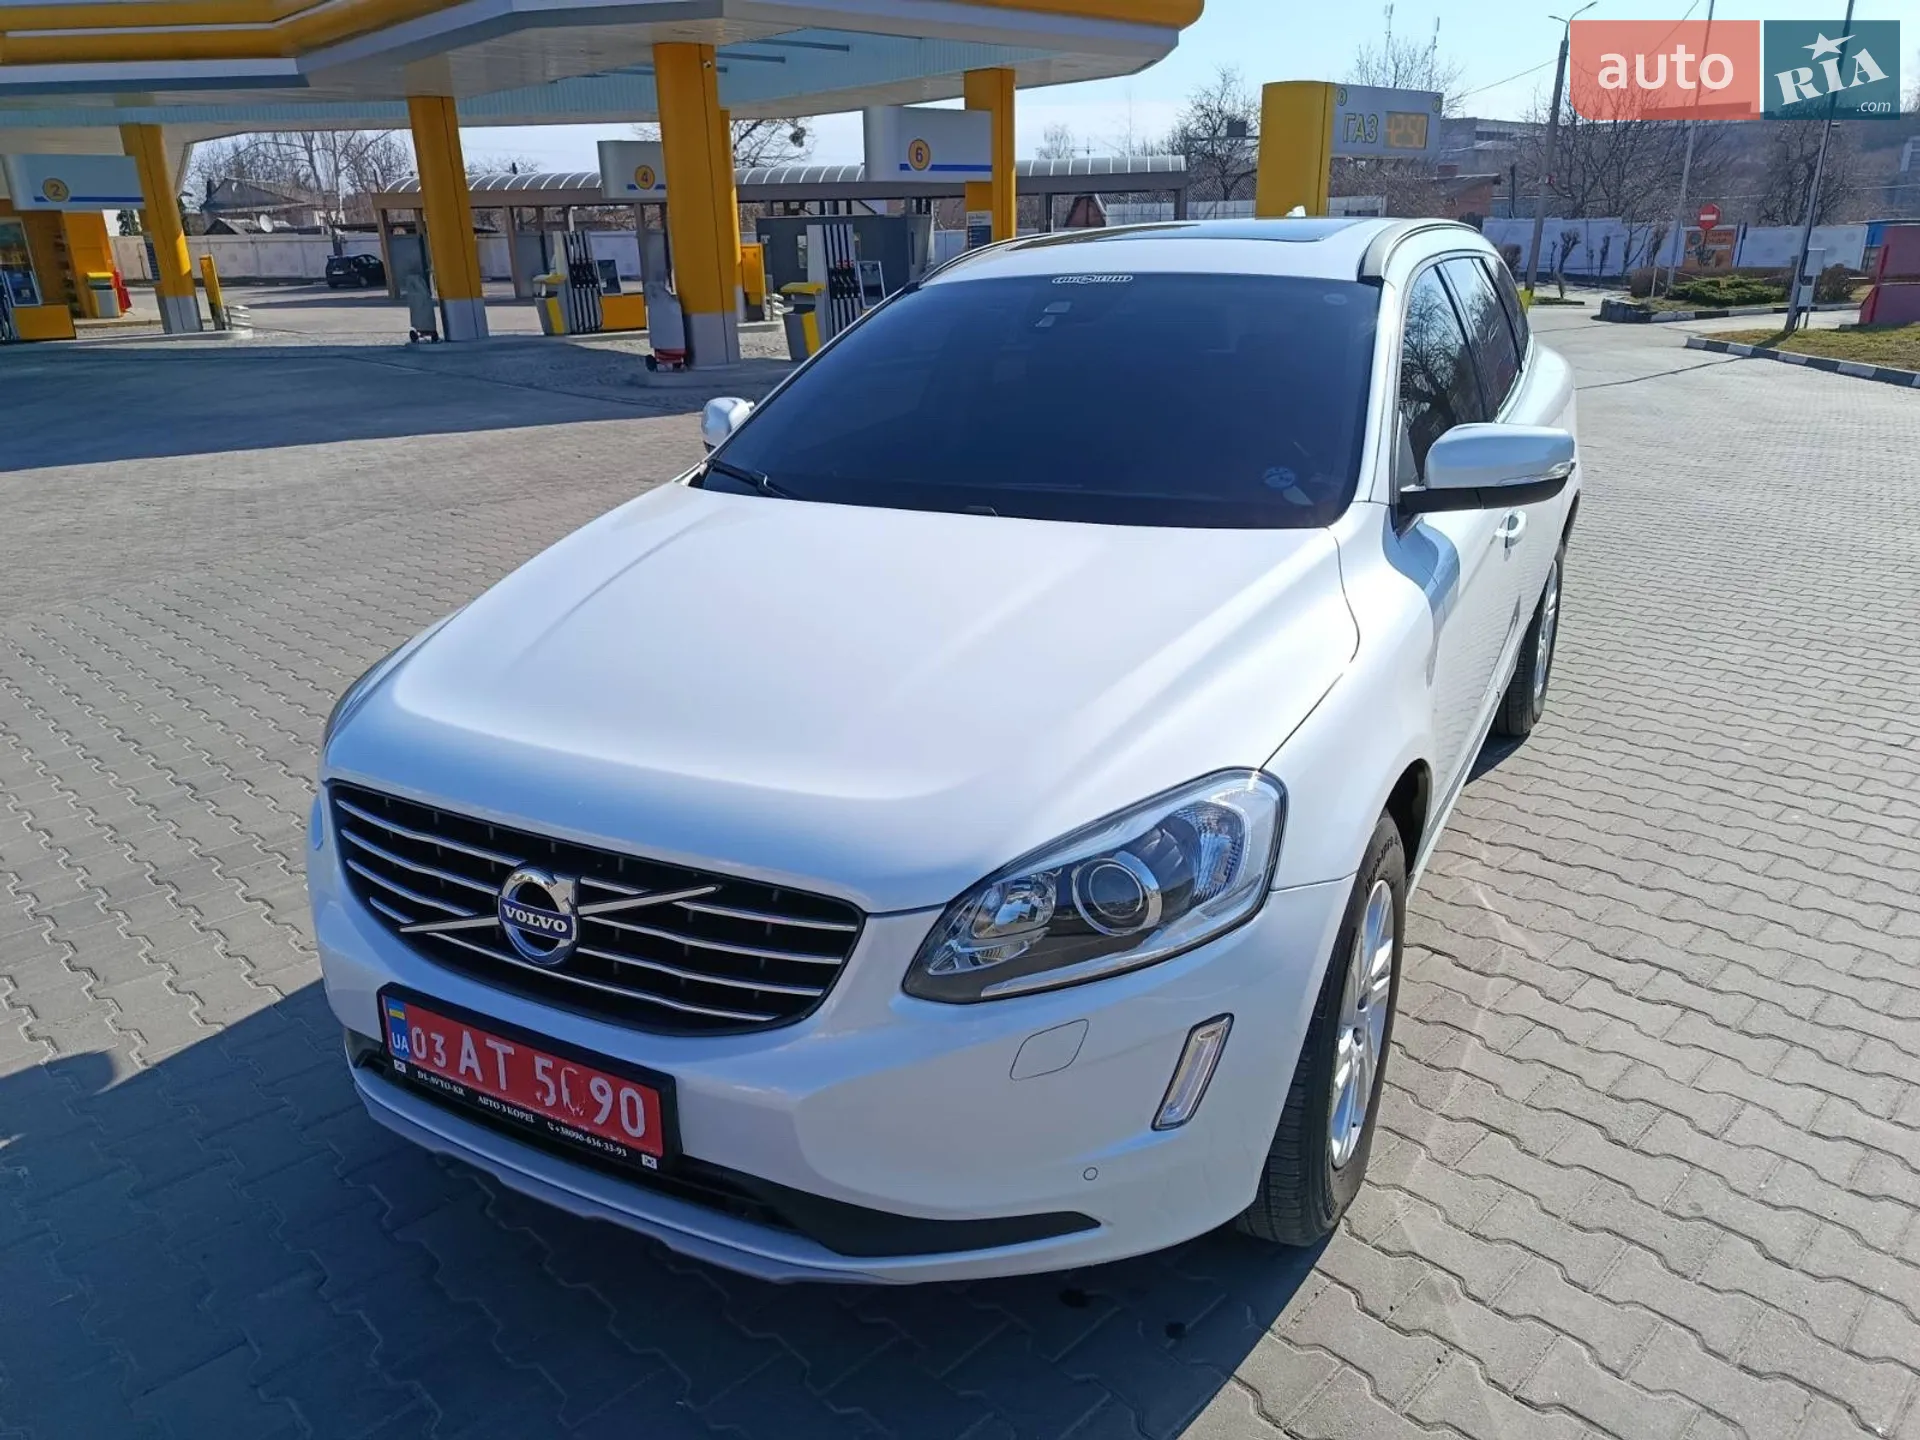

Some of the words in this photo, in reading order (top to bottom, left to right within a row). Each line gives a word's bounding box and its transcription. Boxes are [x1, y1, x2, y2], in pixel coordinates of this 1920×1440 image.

[1343, 112, 1379, 144] ГАЗ
[503, 904, 567, 933] VOLVO
[392, 1032, 410, 1053] UA
[411, 1026, 447, 1068] 03
[459, 1030, 515, 1091] AT
